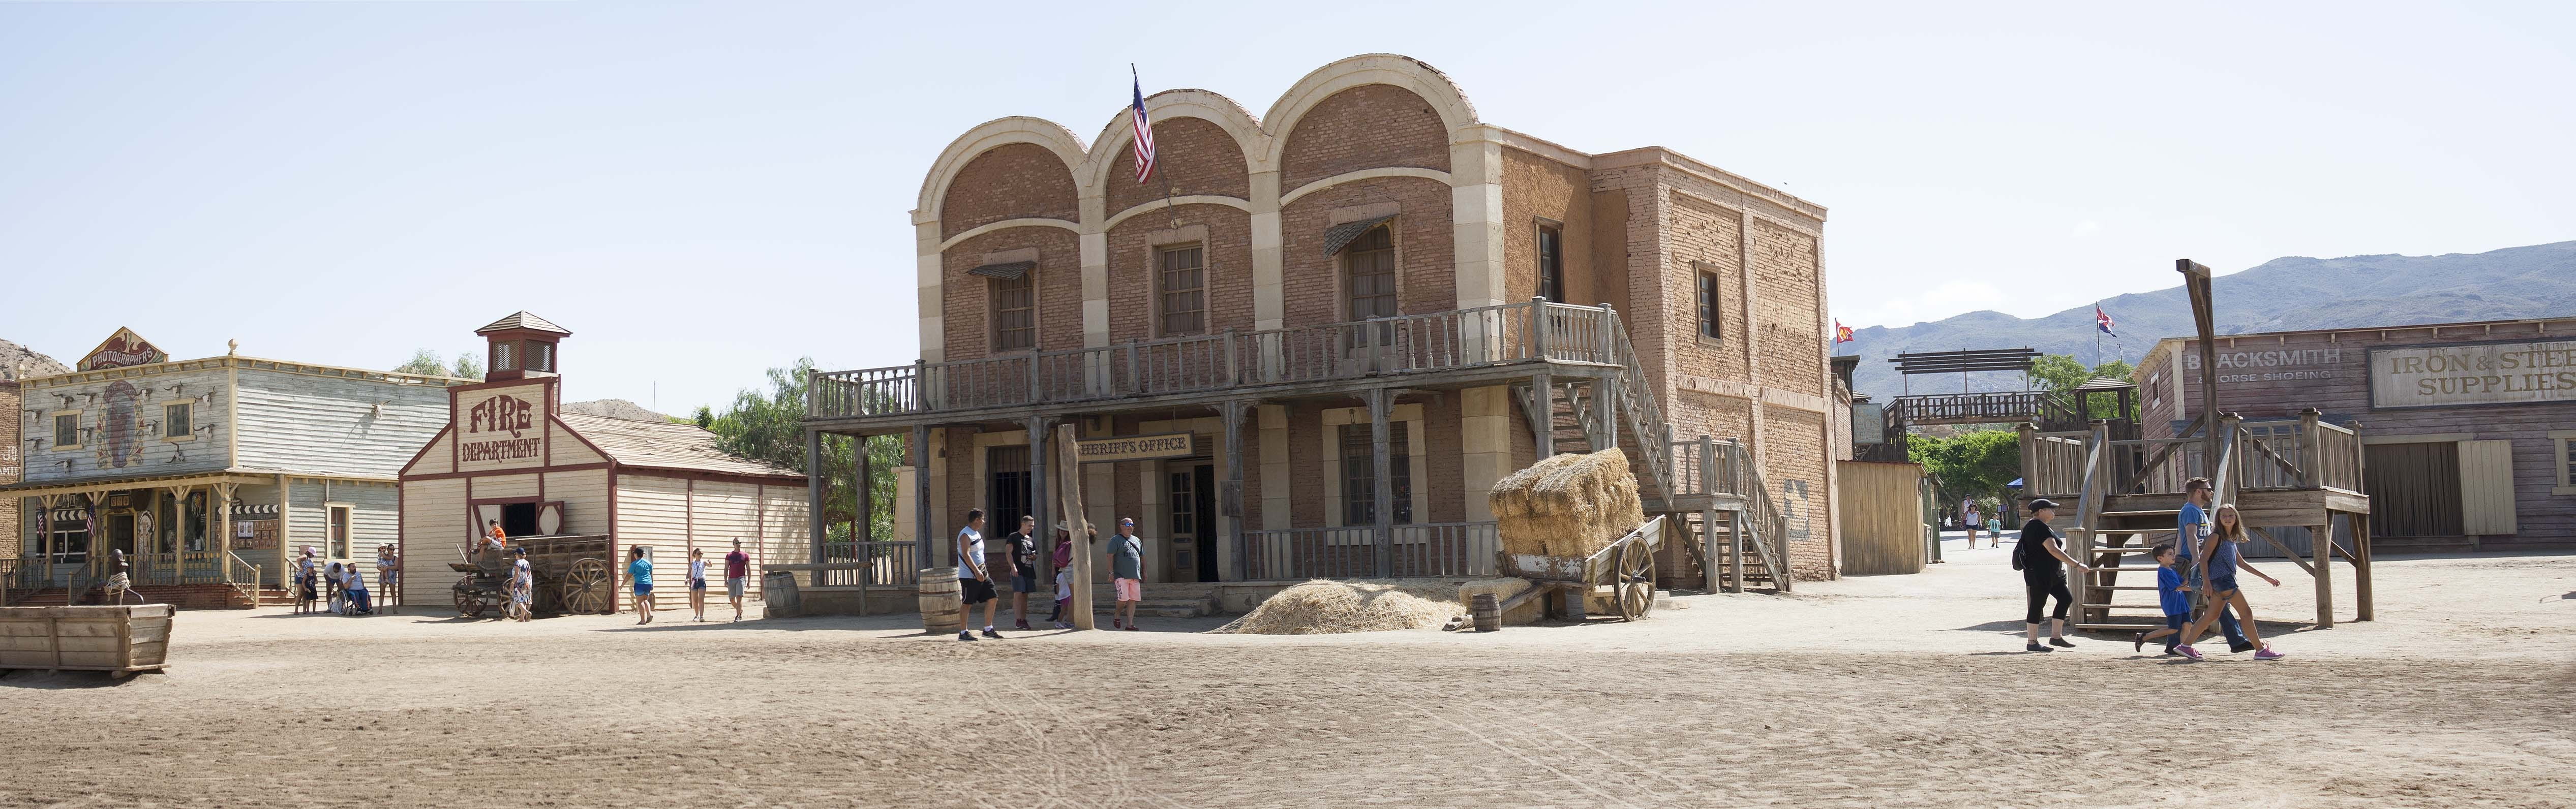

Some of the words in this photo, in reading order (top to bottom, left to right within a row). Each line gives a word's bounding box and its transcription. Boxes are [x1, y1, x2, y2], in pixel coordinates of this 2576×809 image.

[92, 347, 153, 366] PHOTOGRAPHERS
[2188, 349, 2340, 370] BACKSMITH
[2391, 354, 2470, 375] IRON
[2476, 356, 2491, 371] &
[2217, 374, 2257, 384] ORSE
[2263, 370, 2331, 381] SHOEING
[2418, 371, 2576, 396] SUPPLIES
[470, 394, 532, 439] FIRE
[463, 437, 541, 463] DEPARTMENT
[1138, 437, 1187, 453] OFFICE
